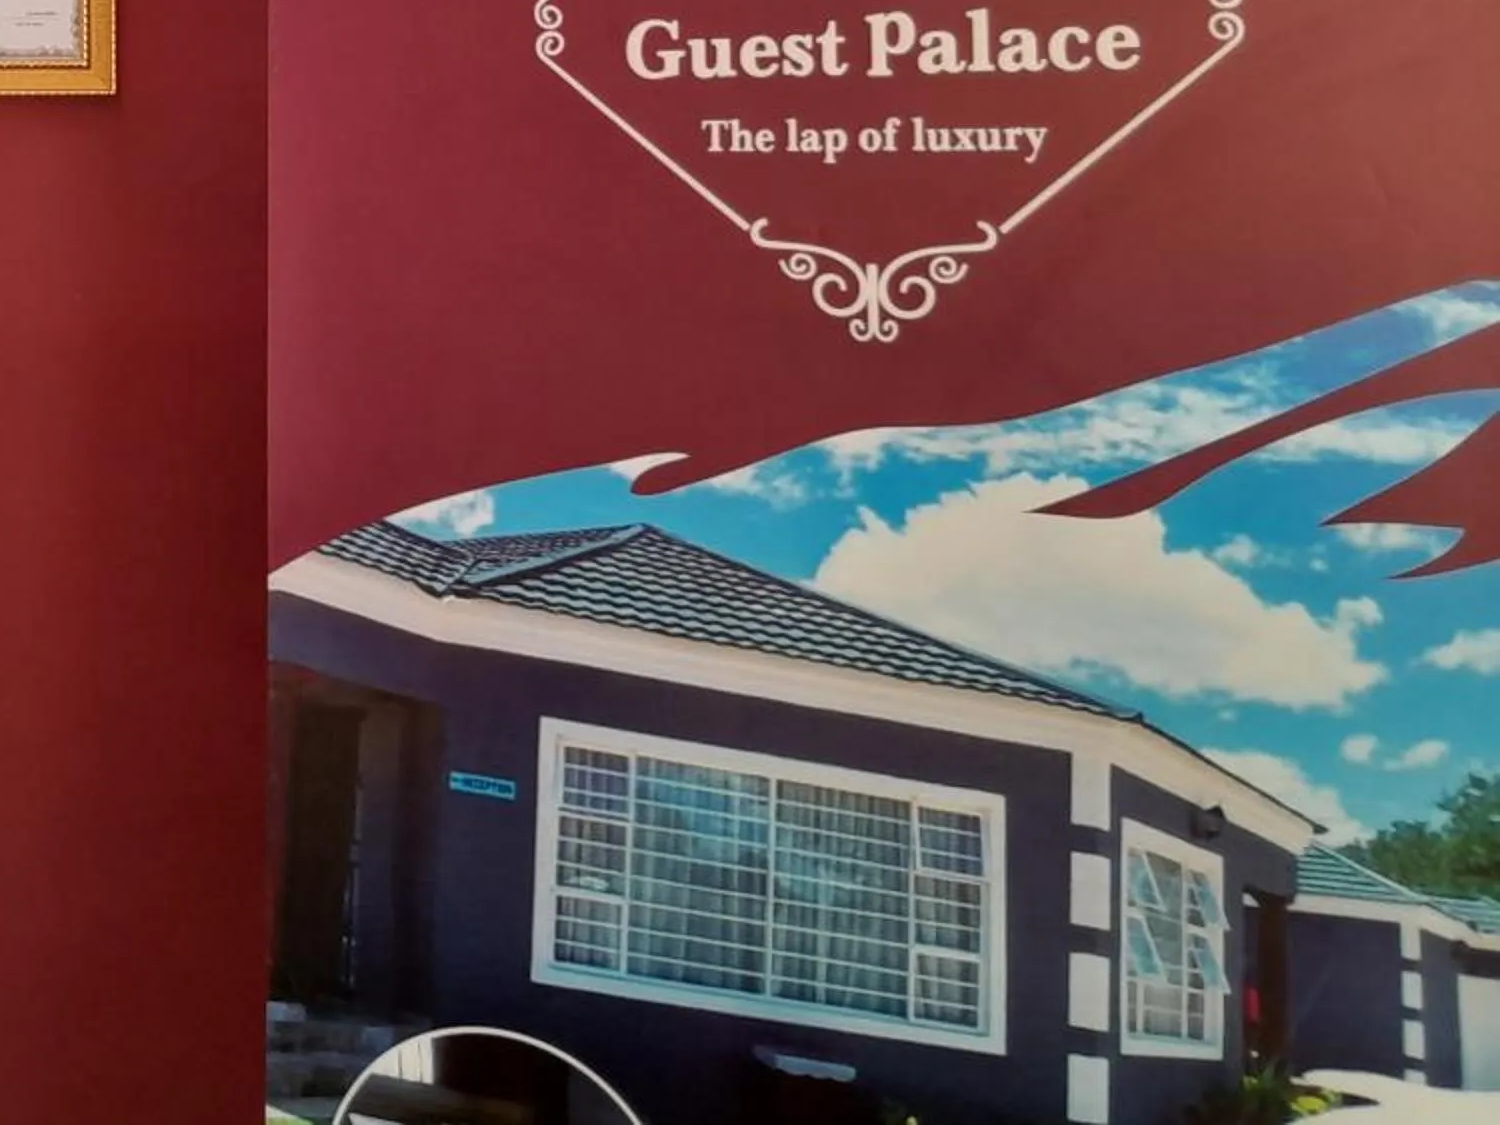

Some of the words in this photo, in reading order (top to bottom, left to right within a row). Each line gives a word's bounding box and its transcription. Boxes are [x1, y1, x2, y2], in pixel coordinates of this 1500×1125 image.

[625, 18, 849, 80] Guest
[864, 7, 1141, 77] Palace
[701, 118, 776, 153] The
[786, 118, 848, 164] lap
[858, 117, 902, 153] of
[912, 116, 1048, 164] luxury
